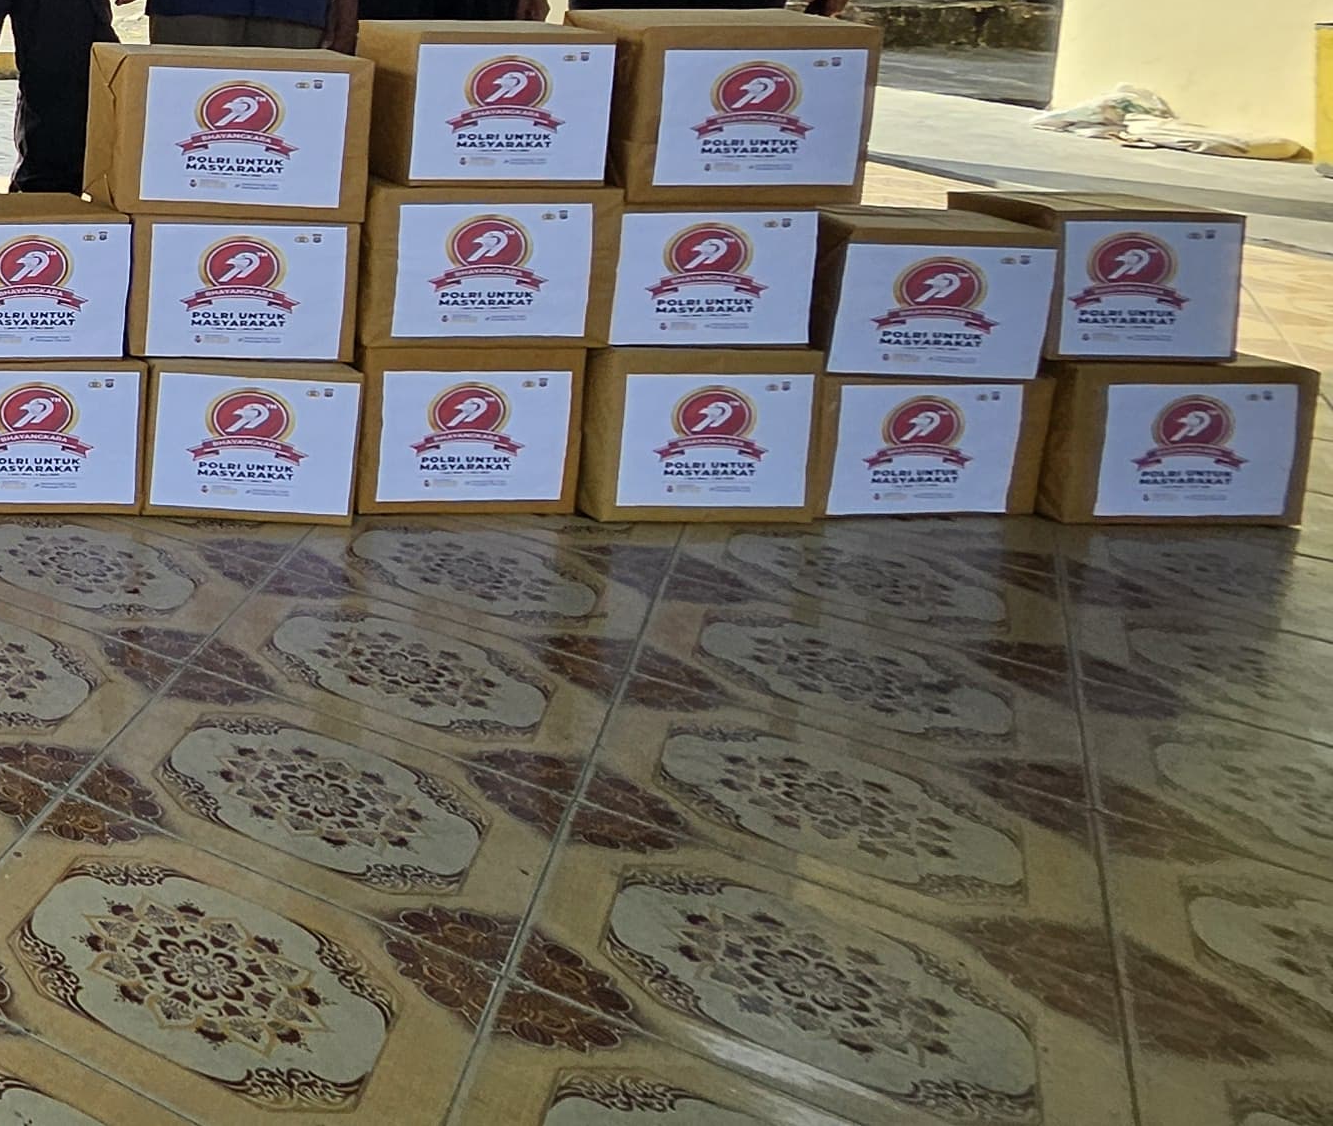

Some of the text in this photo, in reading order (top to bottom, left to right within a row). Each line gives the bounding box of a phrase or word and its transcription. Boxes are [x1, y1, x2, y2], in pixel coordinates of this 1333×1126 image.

[201, 133, 271, 143] BHAYANGKARA
[187, 155, 283, 167] POLRI UNTUK
[185, 163, 284, 174] MASYARAKAT
[440, 290, 534, 300] POLRI UNTUK
[438, 298, 534, 307] MASYARAKAT
[656, 297, 753, 308] POLRI UNTUK
[655, 304, 754, 315] MASYARAKAT
[1080, 308, 1175, 318] POLRI UNTUK
[30, 310, 75, 320] UNTUK
[1078, 316, 1176, 326] MASYARAKAT
[0, 434, 67, 442] BHAYANGKARA
[34, 456, 80, 466] UNTUK
[664, 461, 755, 470] POLRI UNTUK
[198, 461, 294, 473] POLRI UNTUK
[197, 469, 294, 481] MASYARAKAT
[663, 468, 756, 477] MASYARAKAT
